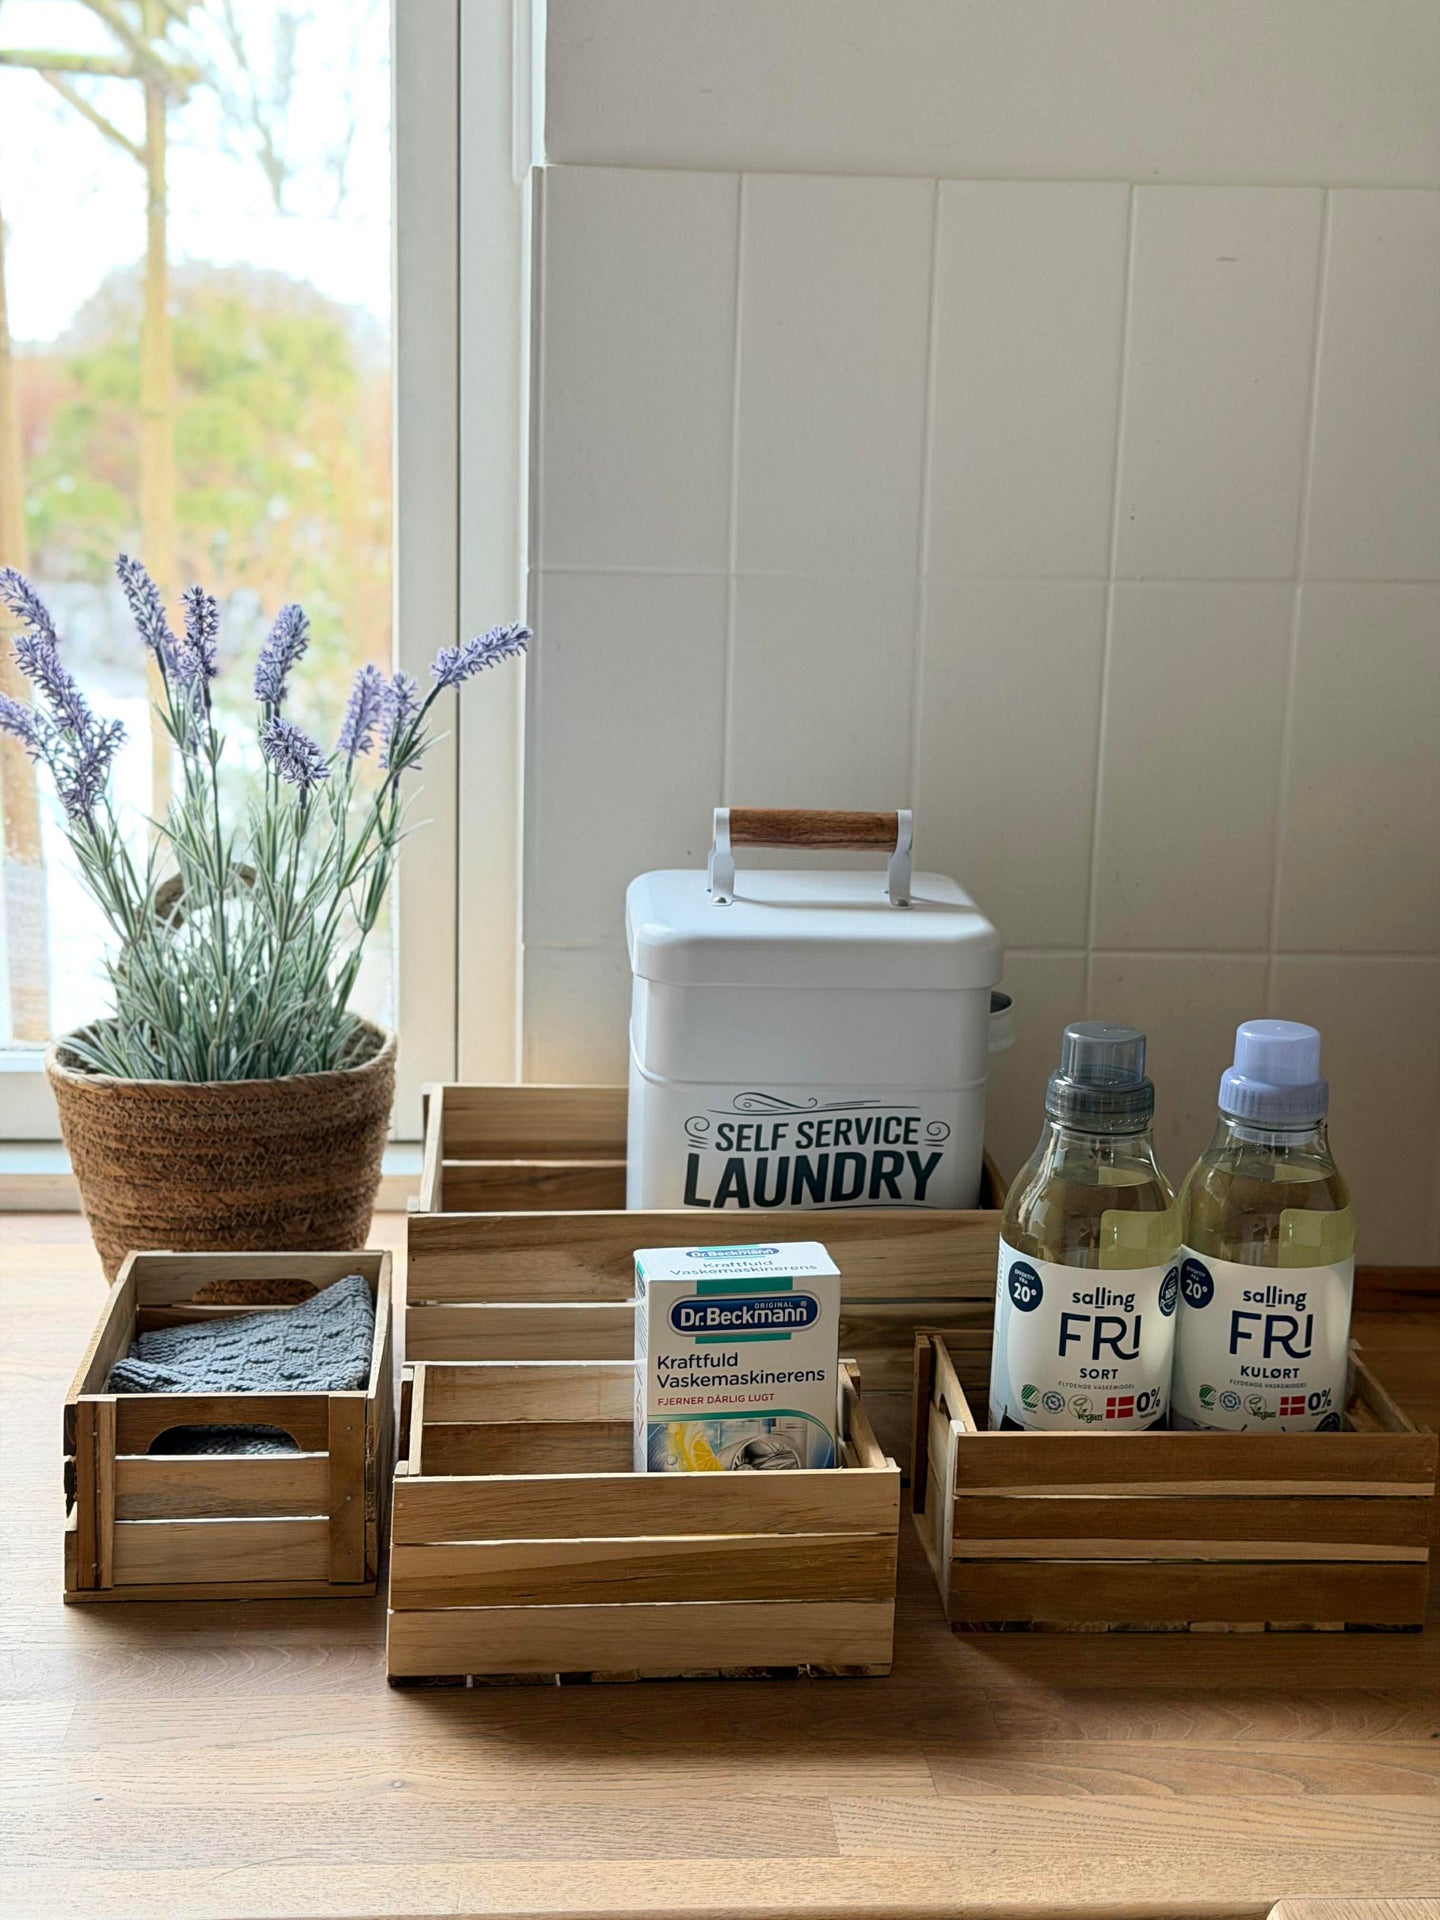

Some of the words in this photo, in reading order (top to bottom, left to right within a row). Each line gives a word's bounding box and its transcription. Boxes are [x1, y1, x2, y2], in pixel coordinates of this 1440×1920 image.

[715, 1123, 789, 1152] SELF
[795, 1117, 921, 1150] SERVICE
[684, 1151, 944, 1208] LAUNDRY
[670, 1265, 818, 1275] Vaskemaskinerens
[703, 1260, 774, 1268] Kraftfuld
[1072, 1287, 1136, 1313] salling
[1243, 1285, 1307, 1312] salling
[1058, 1312, 1142, 1361] FRI
[1229, 1310, 1313, 1359] FRI
[657, 1352, 739, 1370] Kraftfuld
[656, 1369, 825, 1388] Vaskemaskinerens
[1079, 1368, 1119, 1380] SORT
[1240, 1365, 1300, 1379] KULØRT
[1058, 1381, 1091, 1390] FLYDENDE
[658, 1397, 704, 1406] FJERNER
[707, 1393, 746, 1404] DÅRLIG
[748, 1393, 775, 1402] LUGT
[1136, 1386, 1161, 1412] 0%
[1307, 1387, 1332, 1411] 0%
